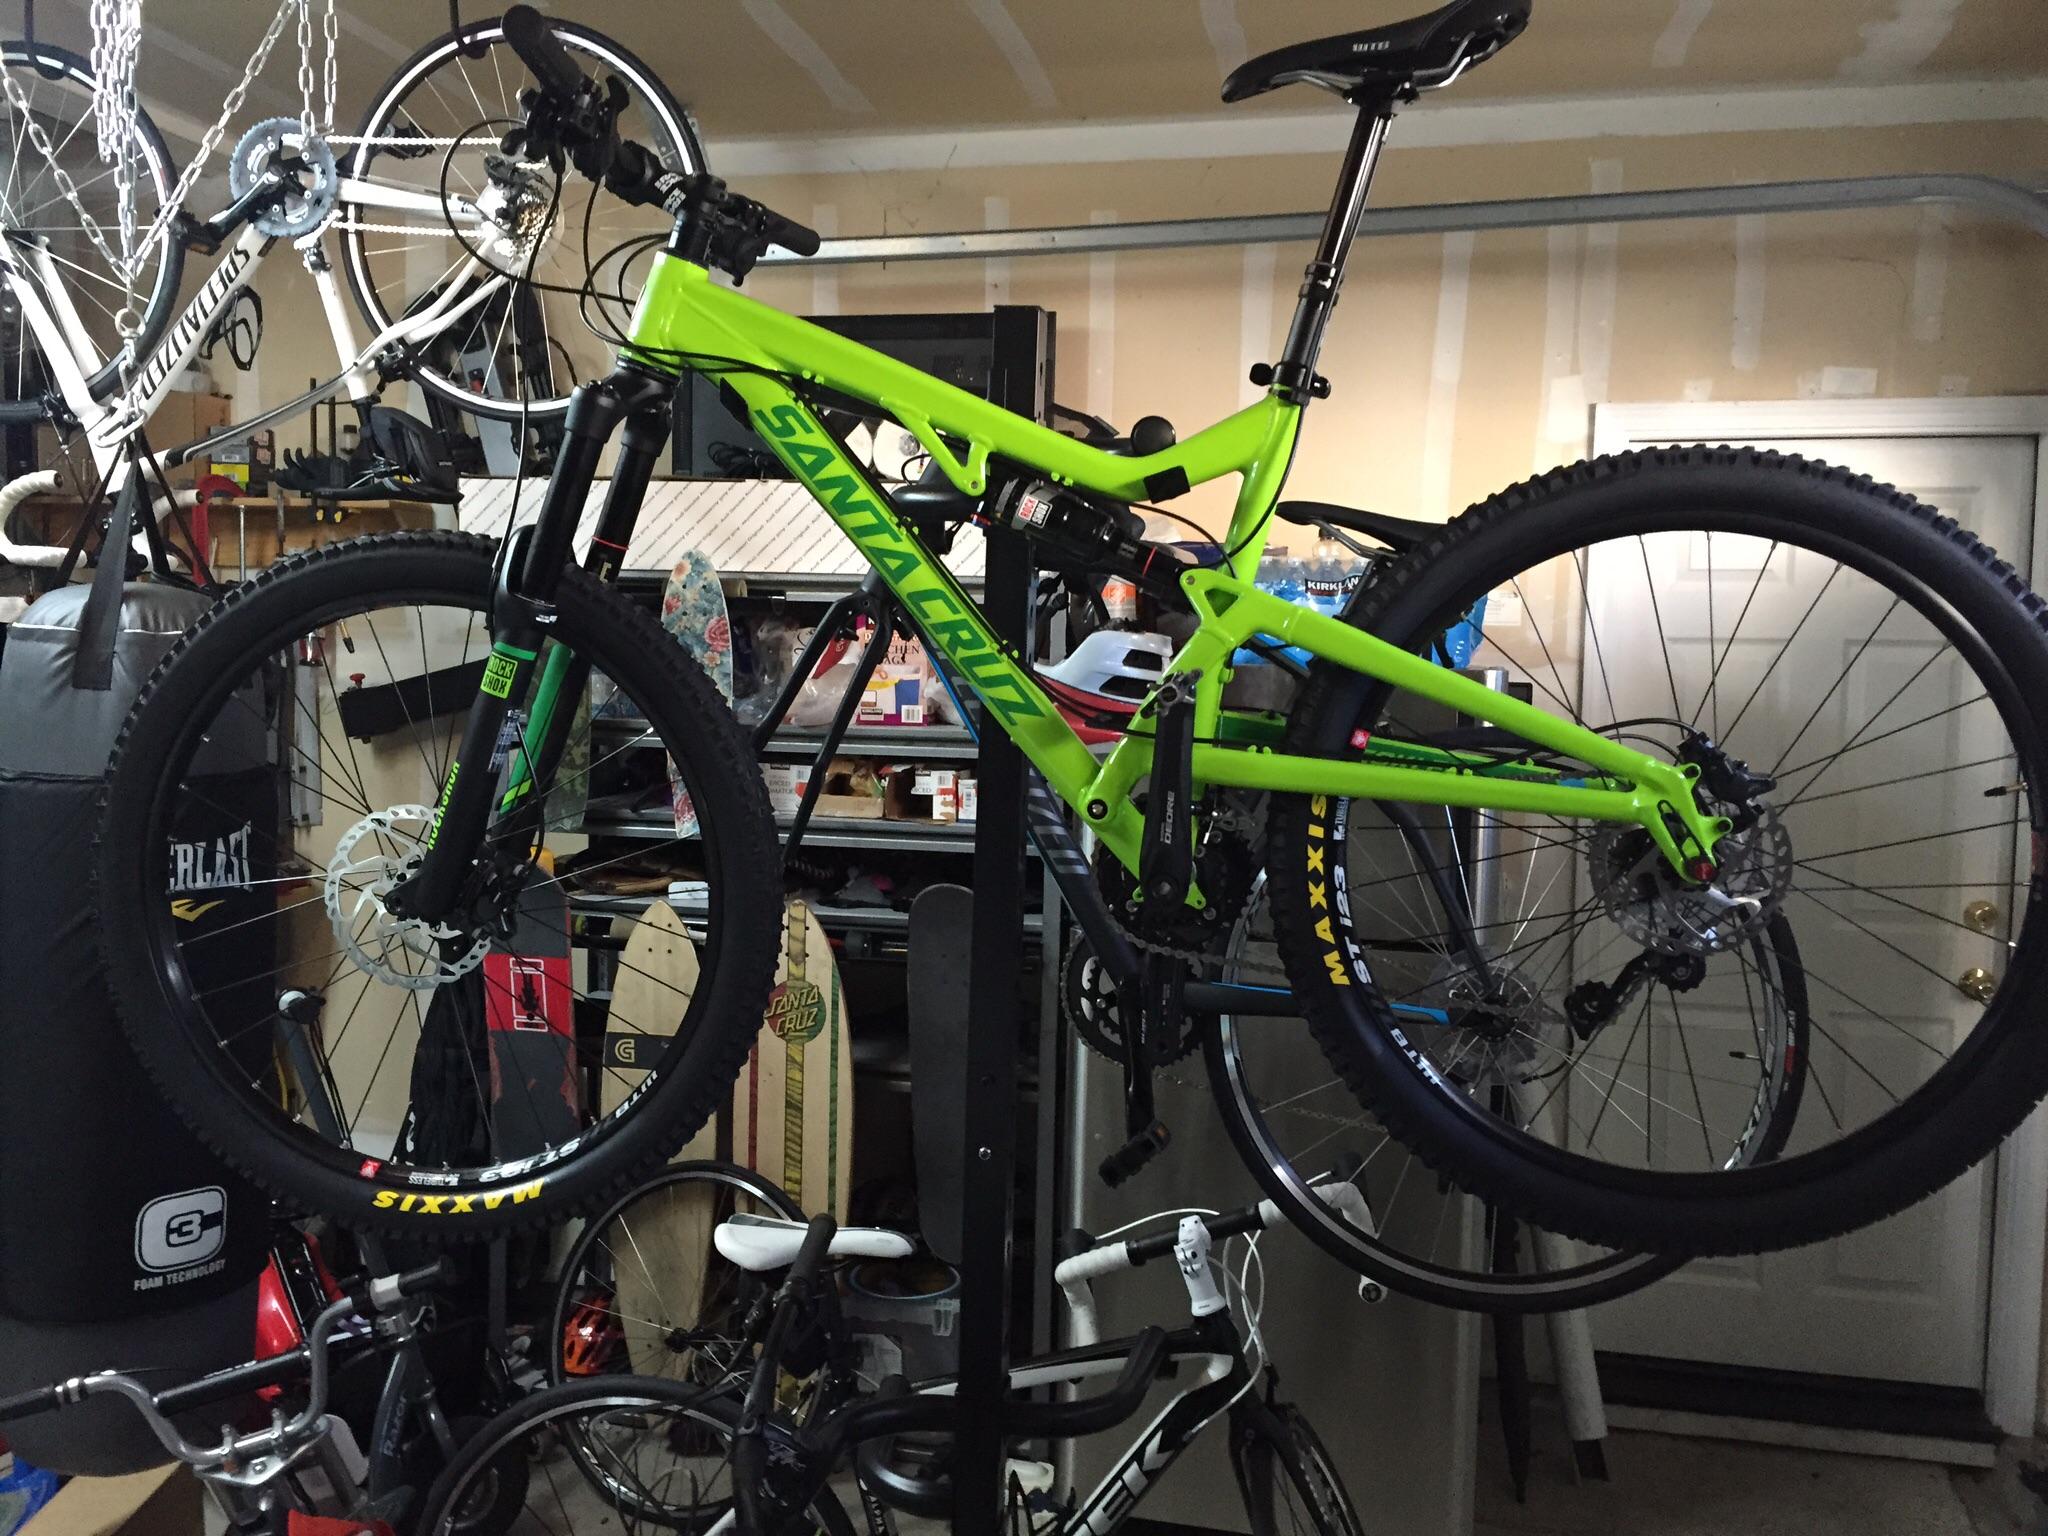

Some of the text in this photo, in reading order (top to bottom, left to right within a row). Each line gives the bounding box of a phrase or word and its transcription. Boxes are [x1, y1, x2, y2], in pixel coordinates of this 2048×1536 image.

[140, 247, 251, 401] SPECIALIZED
[1019, 498, 1037, 519] ROCK
[1032, 502, 1049, 524] SHOX
[754, 404, 921, 584] SANTA
[907, 588, 1047, 727] CRUZ
[483, 672, 506, 694] SHOX
[487, 654, 514, 679] ROCK
[1307, 795, 1350, 986] MAXXIS
[763, 985, 821, 1019] SANTA
[776, 1007, 819, 1036] CRUZ
[1390, 1028, 1442, 1085] WTB
[615, 1070, 658, 1119] WTB
[372, 1178, 545, 1214] MAXXIS
[134, 1259, 226, 1291] FOAM TECHNOLOGY
